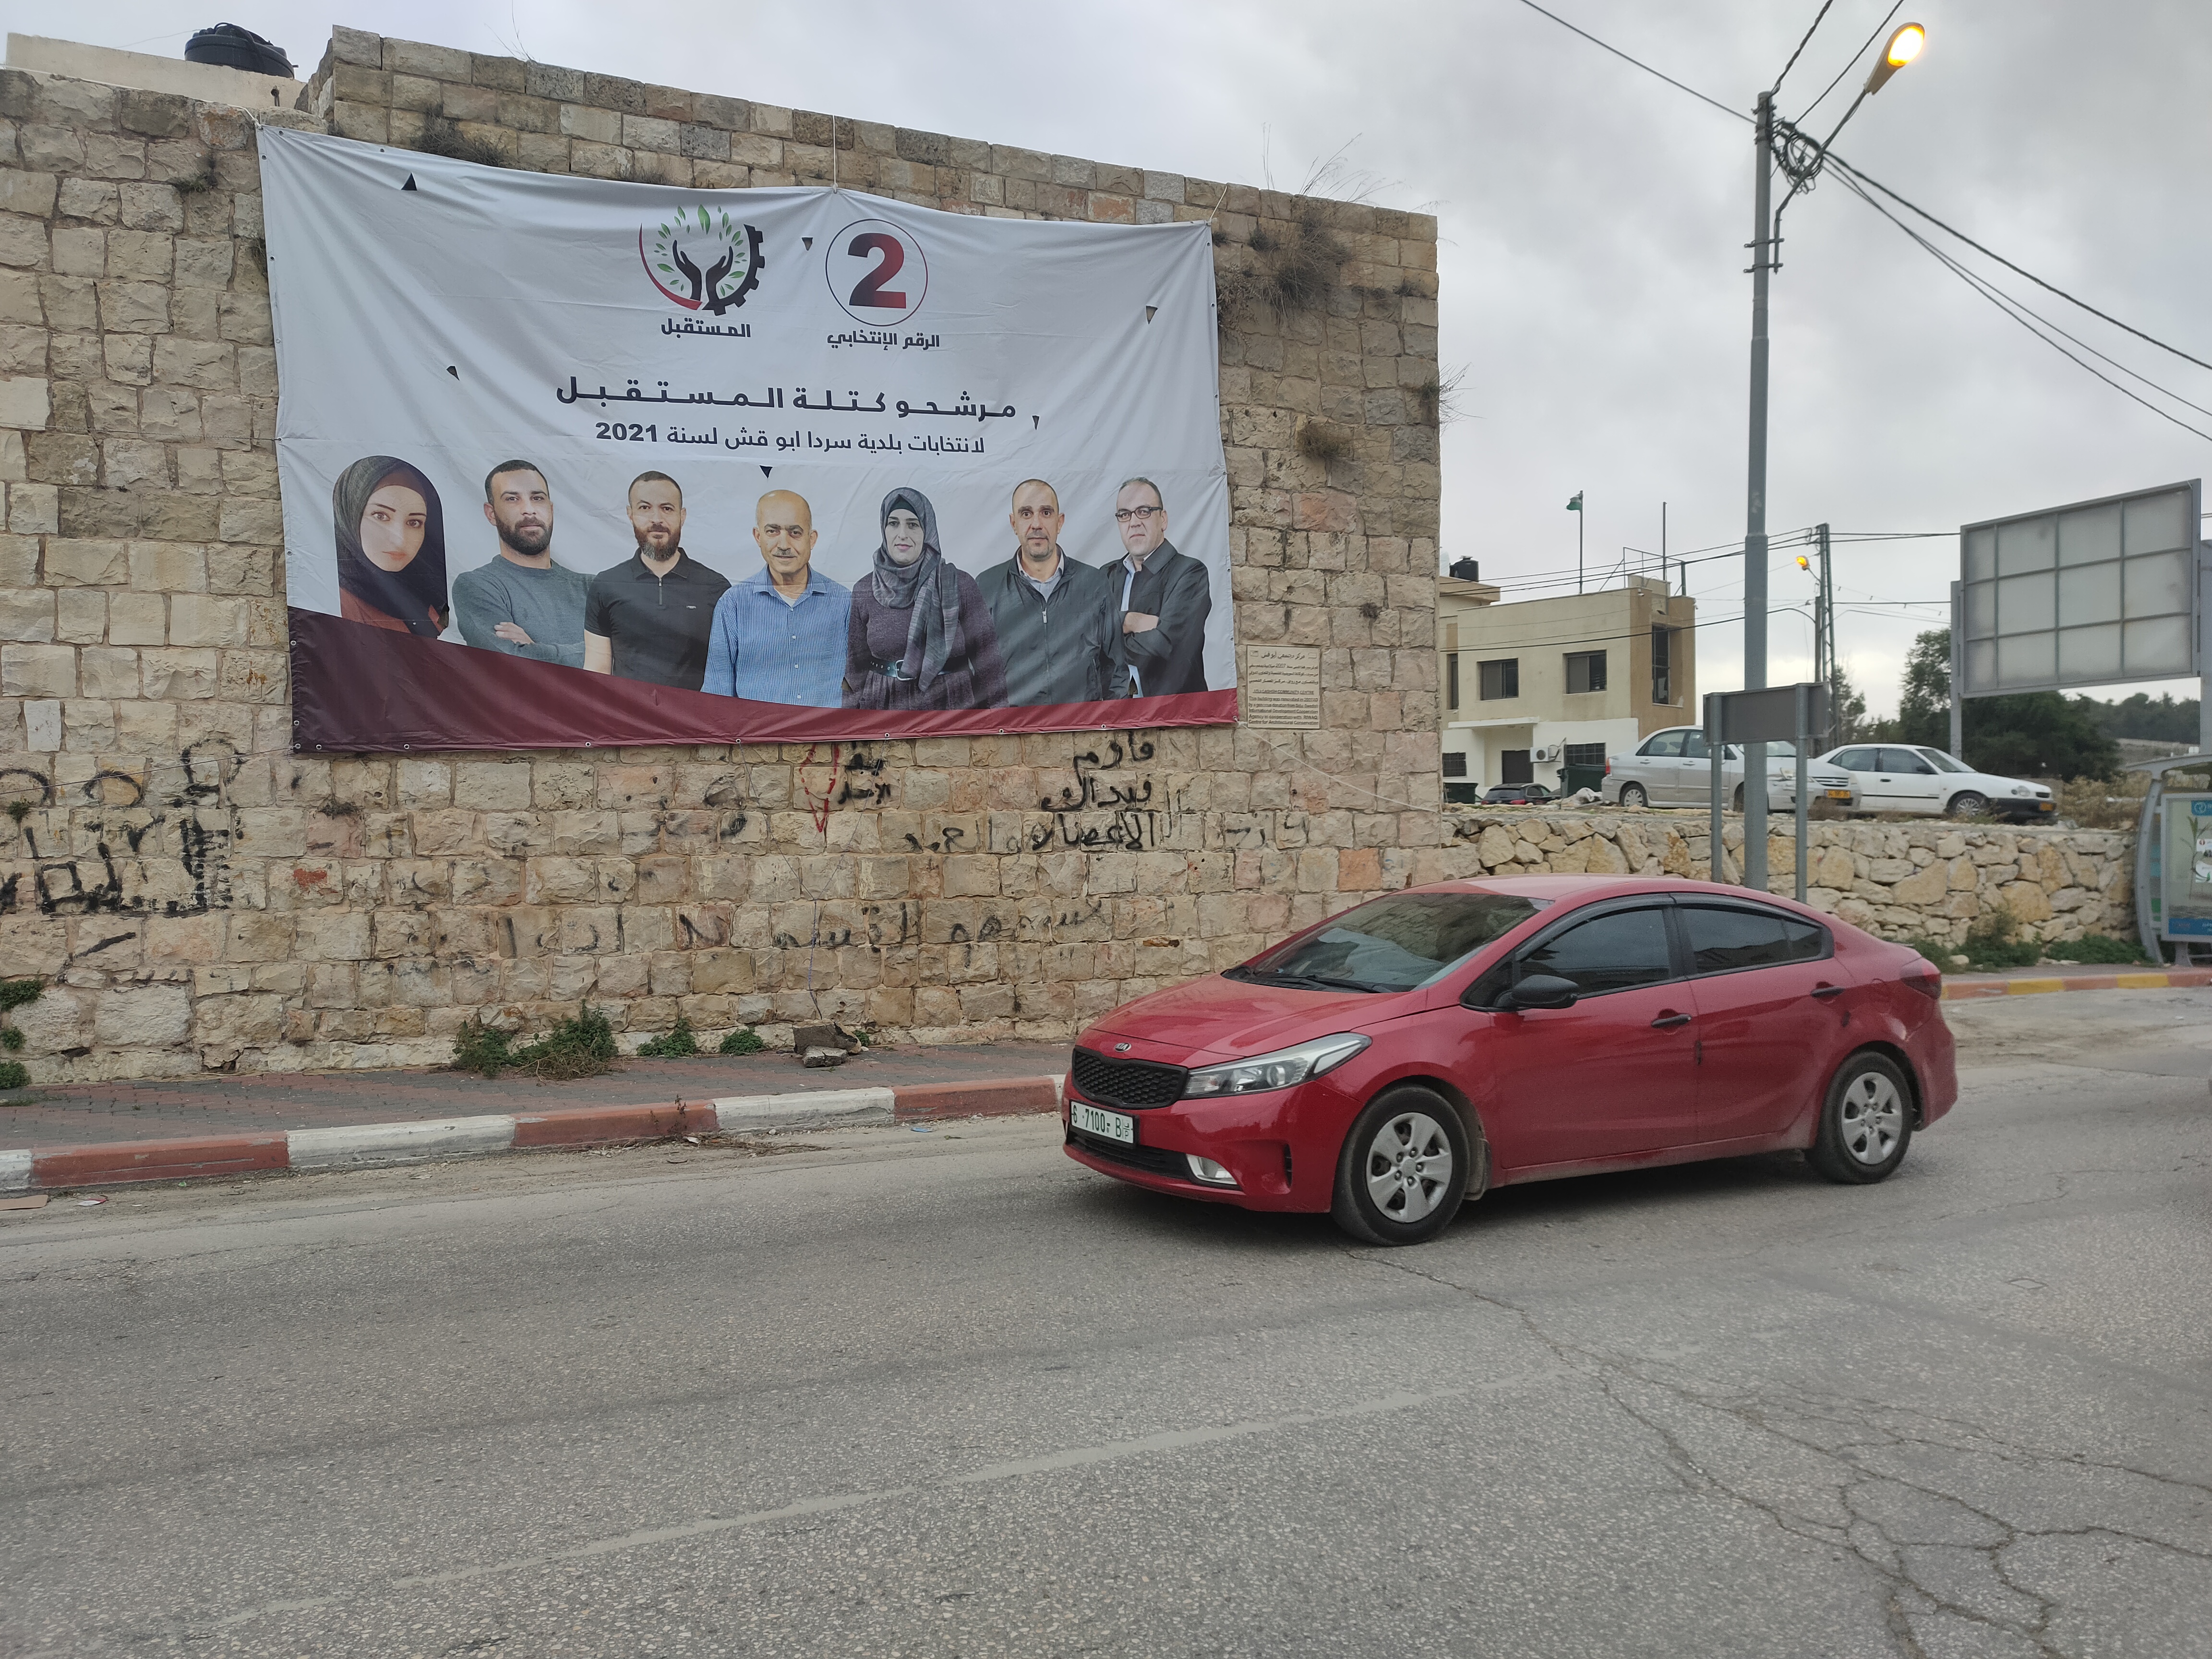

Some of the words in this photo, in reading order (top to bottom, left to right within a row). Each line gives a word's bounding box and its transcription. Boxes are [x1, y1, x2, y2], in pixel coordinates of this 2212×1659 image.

[848, 232, 906, 309] 2
[661, 318, 751, 337] المستقبل
[827, 330, 897, 351] الإنتخابي
[902, 335, 940, 350] الرقم
[556, 376, 783, 409] المستقبل
[793, 387, 886, 412] كتلة
[896, 390, 1016, 422] مرشحو
[595, 422, 658, 442] 2021
[666, 426, 718, 445] لسنة
[725, 427, 768, 450] قش
[775, 430, 800, 451] ابو
[807, 430, 851, 452] سردا
[857, 433, 902, 452] بلدية
[907, 435, 985, 453] لانتخابات
[1115, 1043, 1129, 1051] KIA
